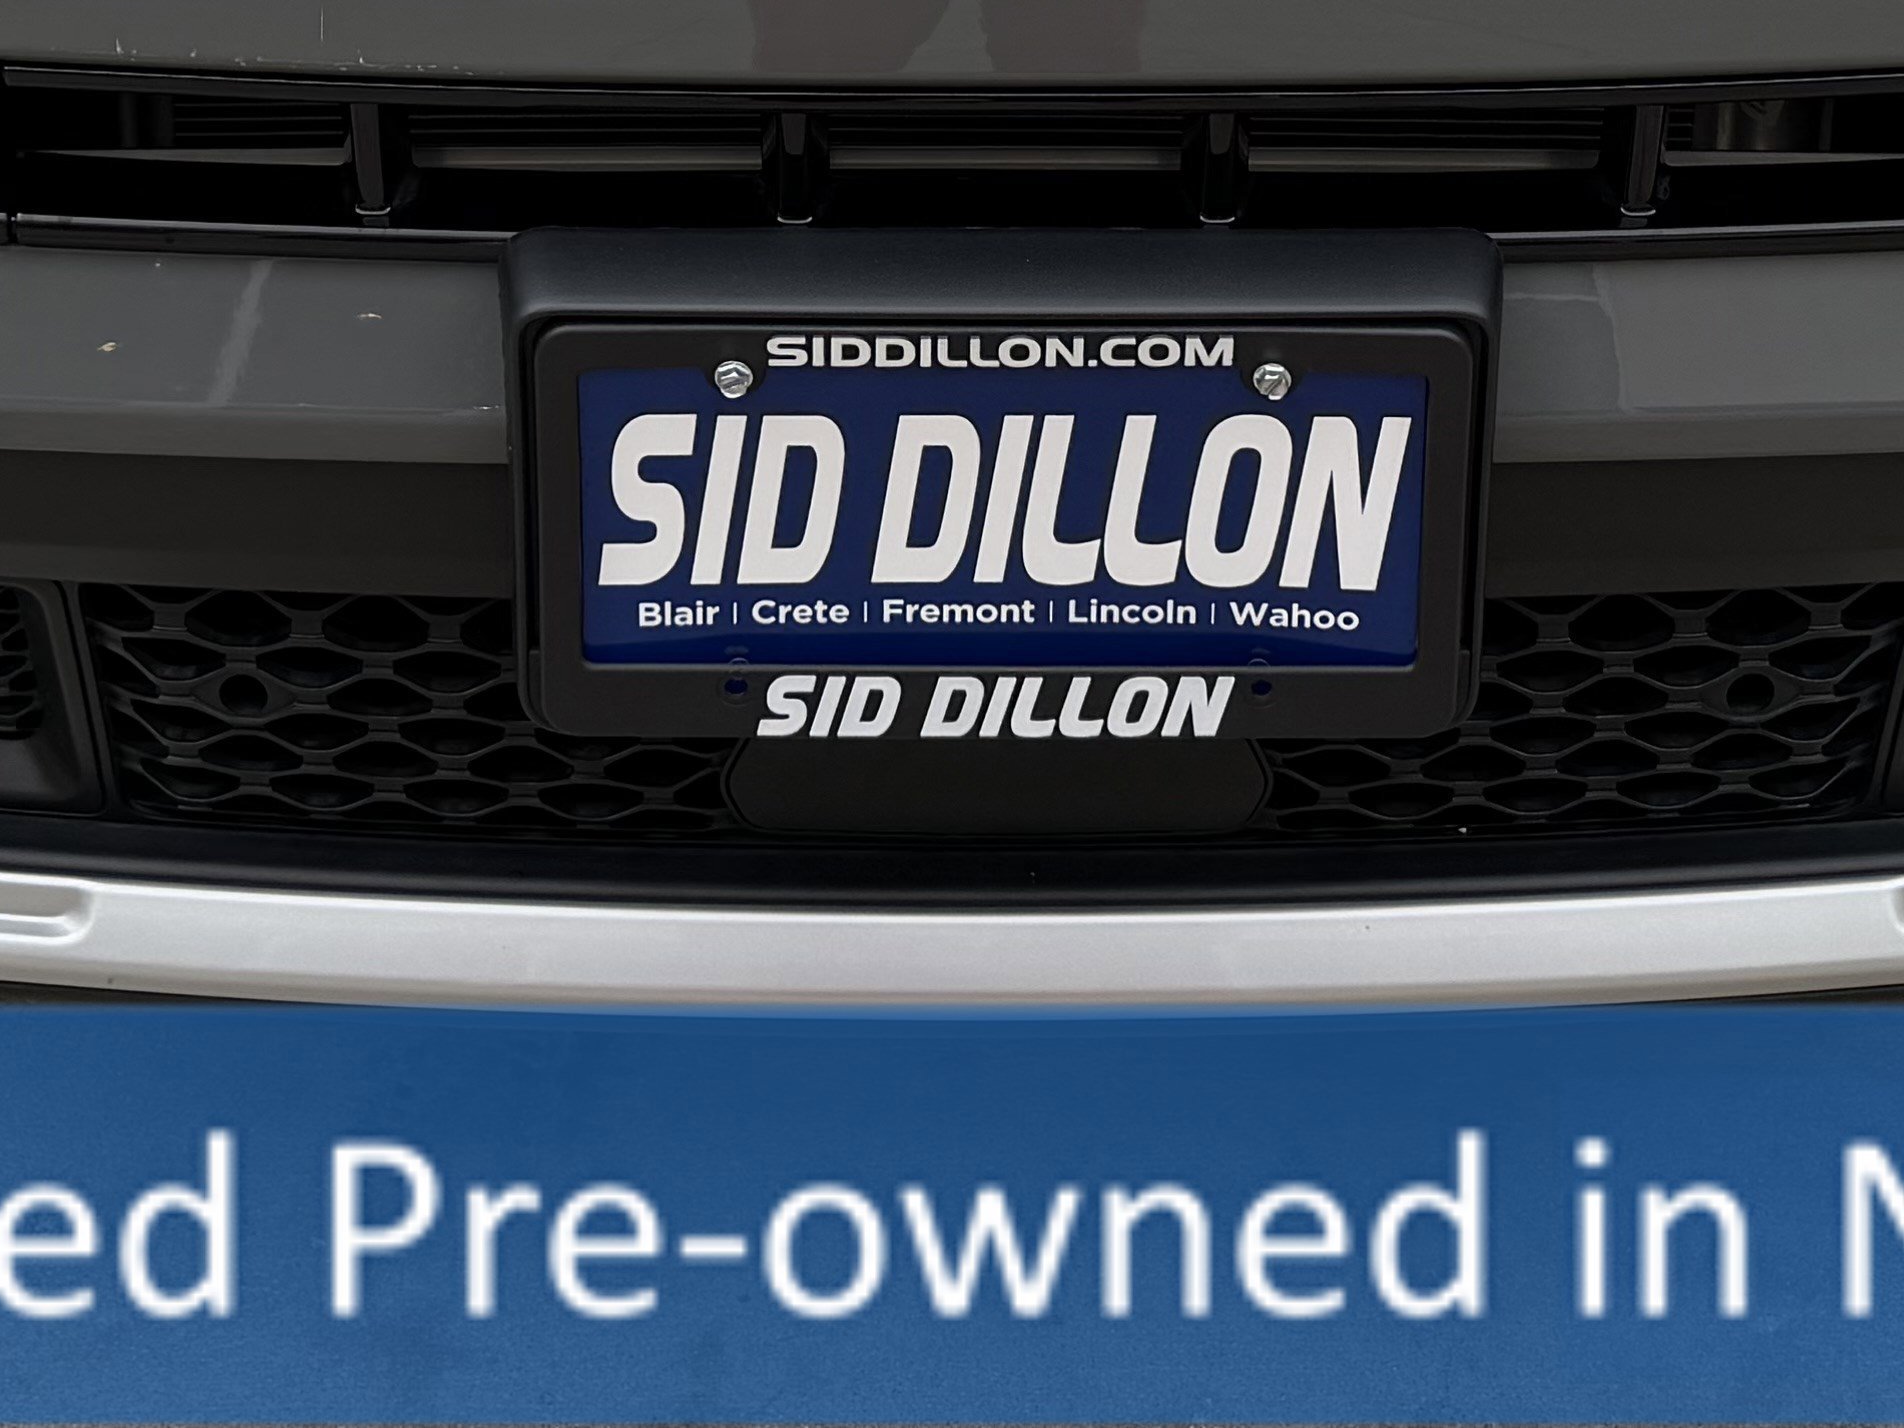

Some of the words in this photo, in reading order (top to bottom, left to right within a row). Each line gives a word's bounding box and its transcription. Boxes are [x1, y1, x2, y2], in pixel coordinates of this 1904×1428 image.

[765, 335, 1235, 369] SIDDILLON.COM
[598, 414, 846, 586] SID
[870, 414, 1412, 591] DILLON
[637, 599, 720, 628] Blair
[751, 598, 850, 626] Crete
[881, 597, 1036, 625] Fremont
[1067, 597, 1198, 626] Lincoln
[1229, 601, 1360, 632] Wahoo
[756, 674, 902, 737] SID
[920, 676, 1236, 738] DILLON
